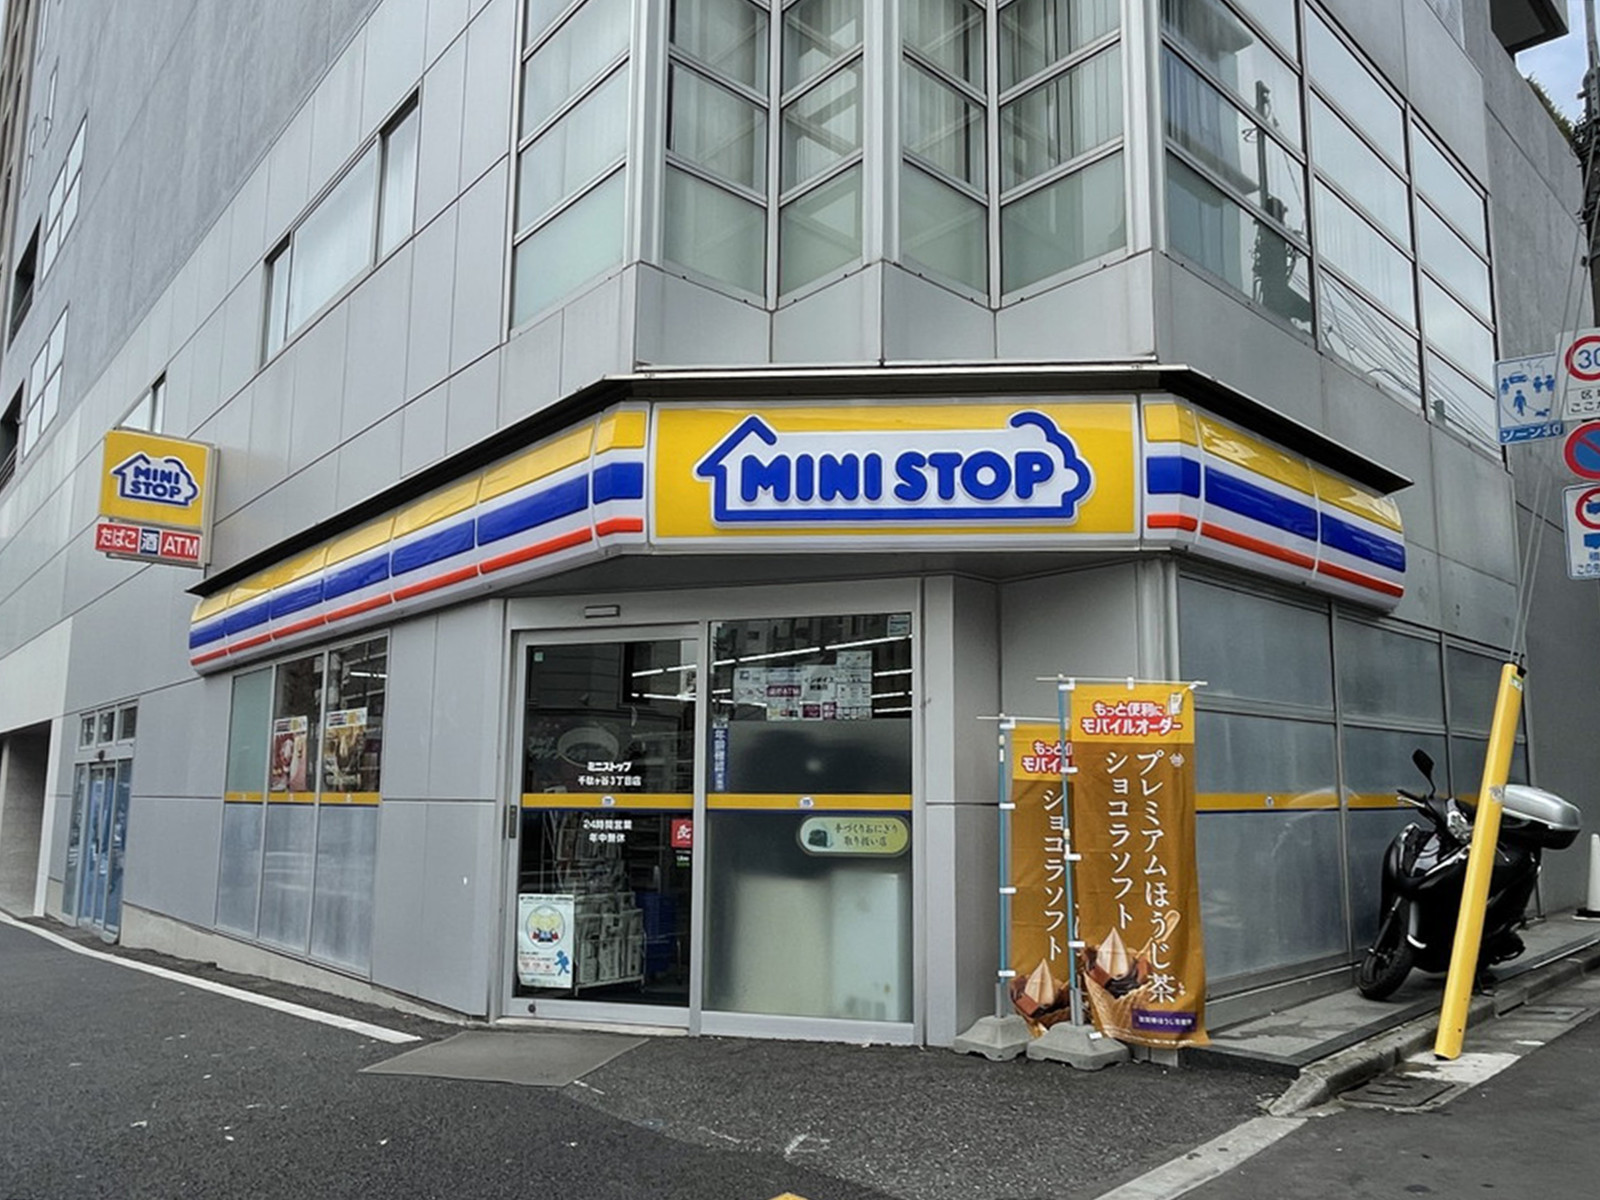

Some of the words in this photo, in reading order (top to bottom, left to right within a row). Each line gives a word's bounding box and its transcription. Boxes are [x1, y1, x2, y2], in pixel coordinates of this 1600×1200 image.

[1581, 389, 1600, 400] 区
[133, 465, 180, 485] MINI
[740, 452, 882, 502] MINI
[893, 450, 1054, 501] STOP
[130, 480, 181, 498] STOP
[99, 527, 136, 549] たばこ
[142, 531, 159, 552] 酒
[163, 535, 198, 556] ATM
[1093, 701, 1164, 717] もっと便利に
[1081, 716, 1182, 735] モバイルオーダー
[1033, 741, 1072, 756] もっと
[587, 761, 632, 772] ミニストップ
[1105, 751, 1134, 930] ショコラソフト
[1042, 789, 1065, 961] ショコラソフト
[1136, 750, 1177, 1003] プレミアムほうじ茶
